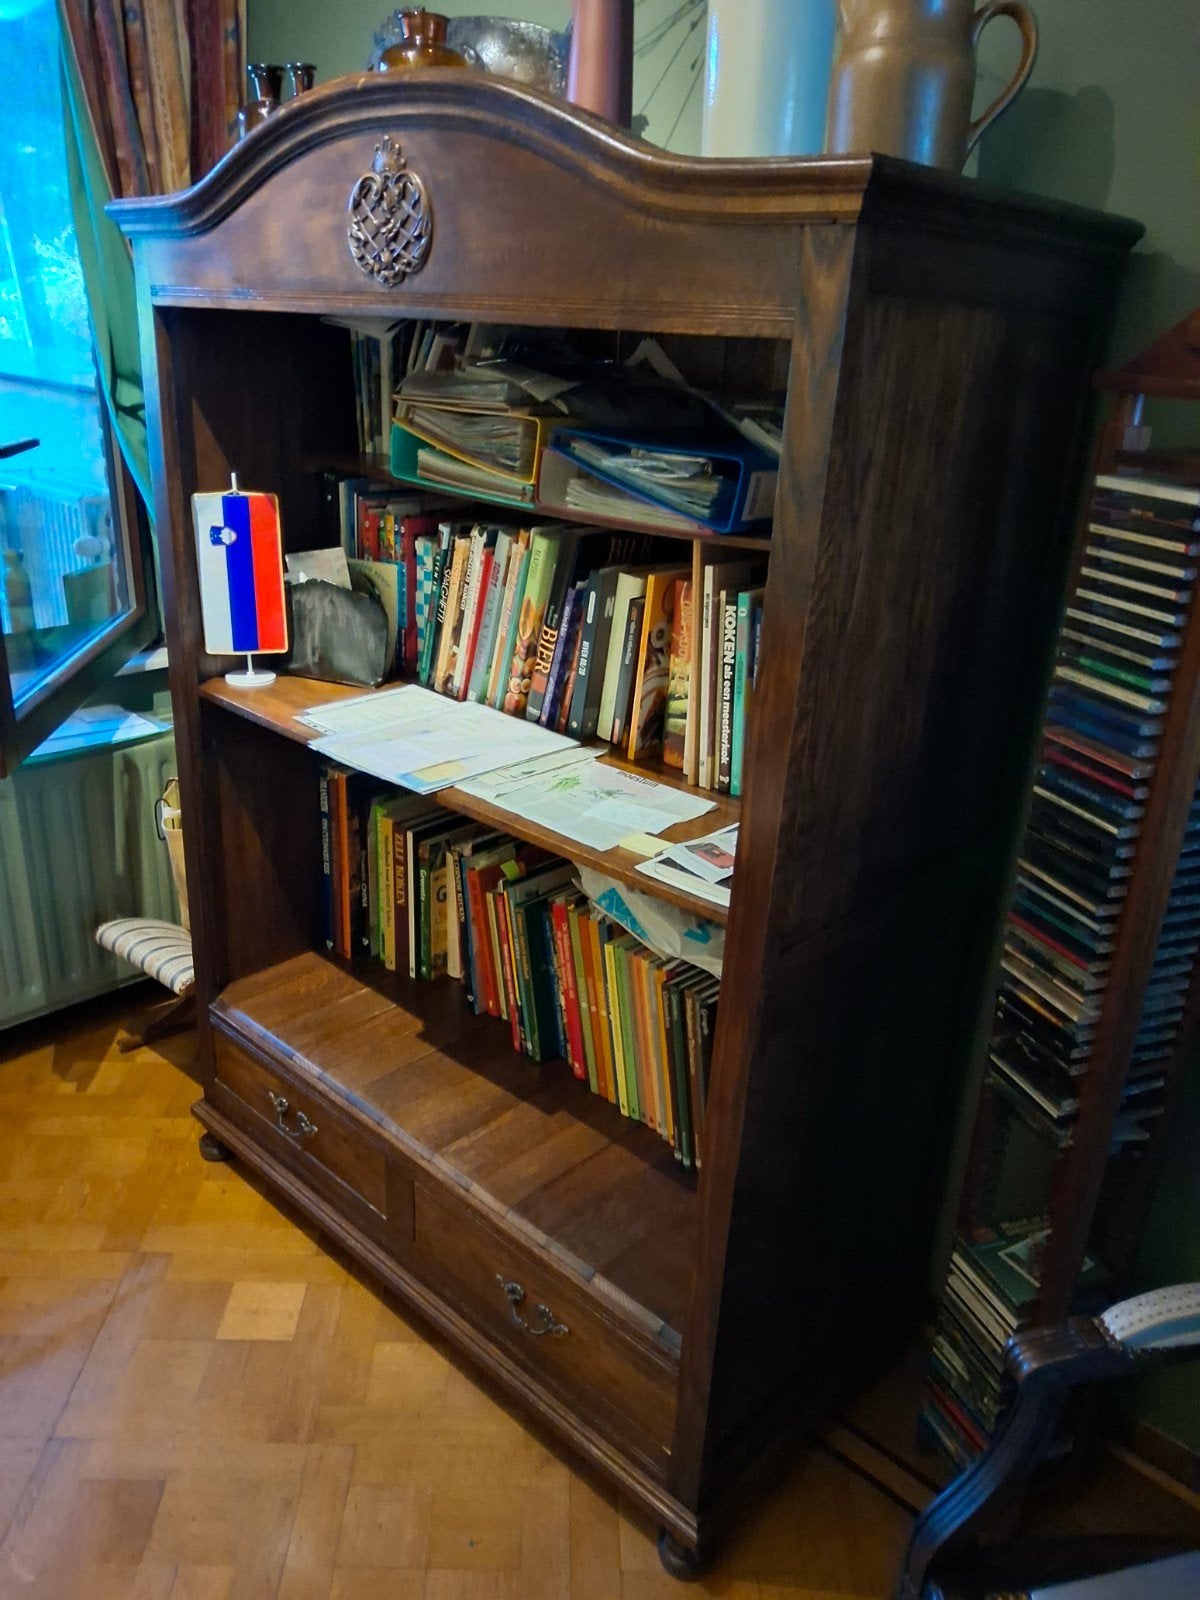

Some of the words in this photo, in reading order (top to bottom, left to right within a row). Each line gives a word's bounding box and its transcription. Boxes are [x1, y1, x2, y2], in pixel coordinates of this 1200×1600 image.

[437, 568, 452, 624] SPAGHETTI
[535, 625, 559, 674] BIER
[723, 605, 737, 664] KOKEN
[723, 664, 733, 680] als
[723, 680, 731, 700] een
[720, 701, 731, 765] meesterkok
[394, 865, 406, 907] KOKEN
[420, 869, 428, 902] Groente
